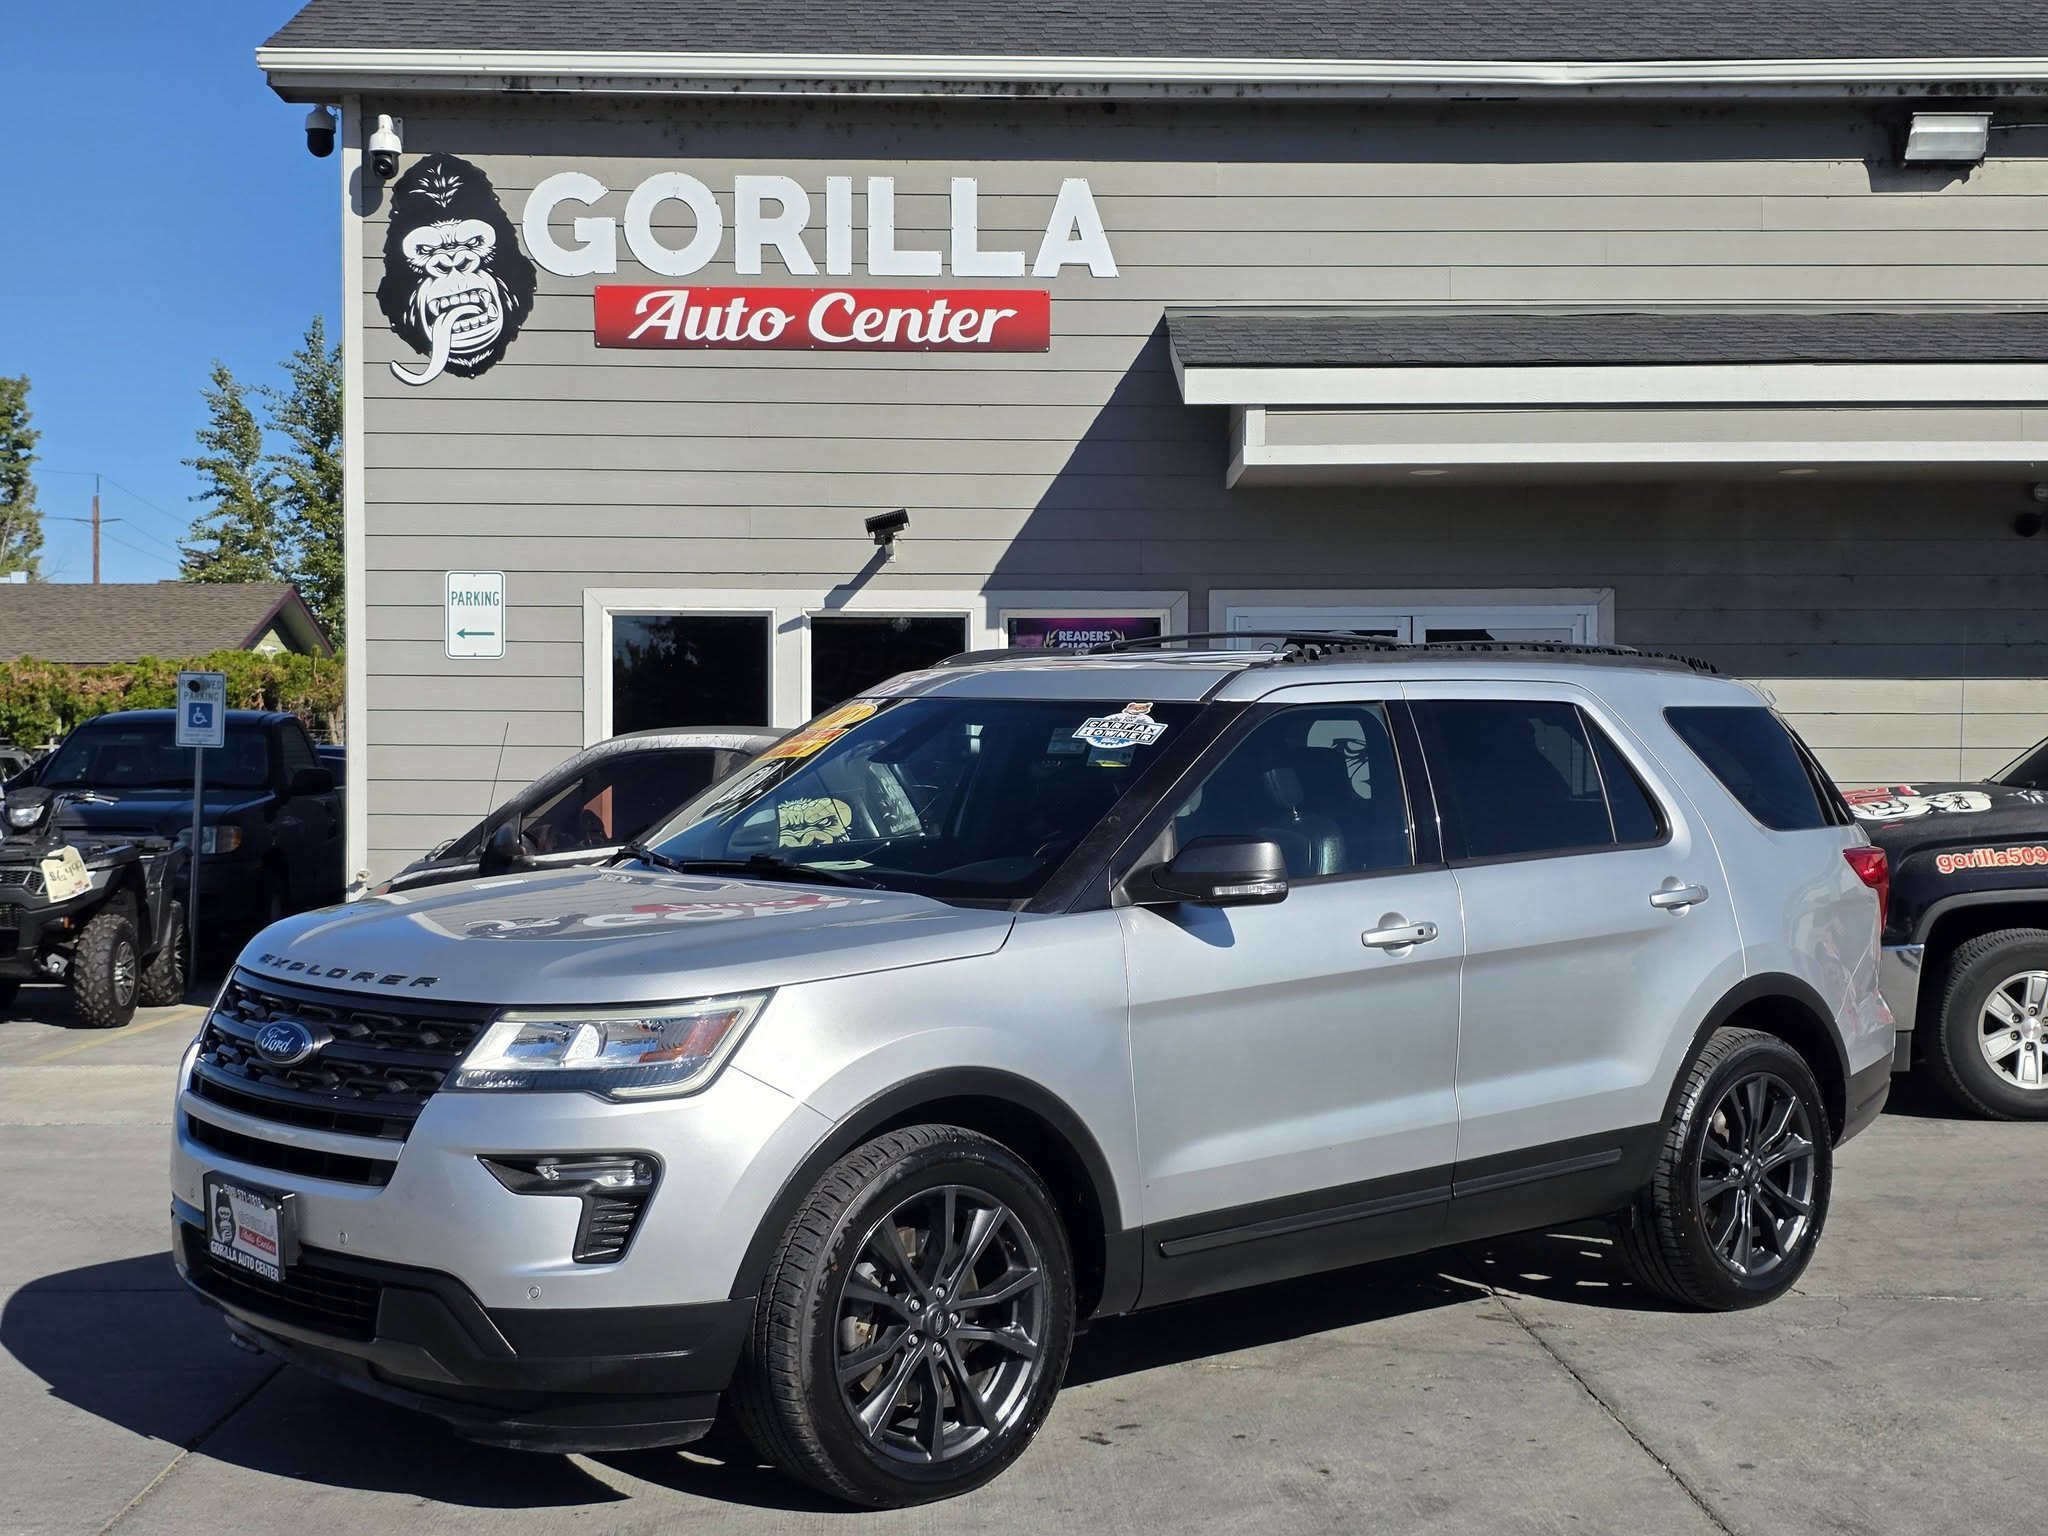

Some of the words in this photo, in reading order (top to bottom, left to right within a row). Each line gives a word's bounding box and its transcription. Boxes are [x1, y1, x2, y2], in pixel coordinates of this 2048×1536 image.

[522, 171, 1119, 279] GORILLA
[627, 289, 794, 342] Auto
[808, 291, 1017, 344] Center
[451, 591, 499, 606] PARKING
[1058, 630, 1113, 641] READERS'
[183, 691, 220, 702] PARKING
[1087, 721, 1157, 734] CARFAX
[1092, 729, 1154, 741] OWNER
[258, 953, 441, 988] EXPLORER
[261, 1026, 295, 1054] Ford
[238, 1252, 255, 1271] AUTO
[255, 1259, 279, 1282] CENTER
